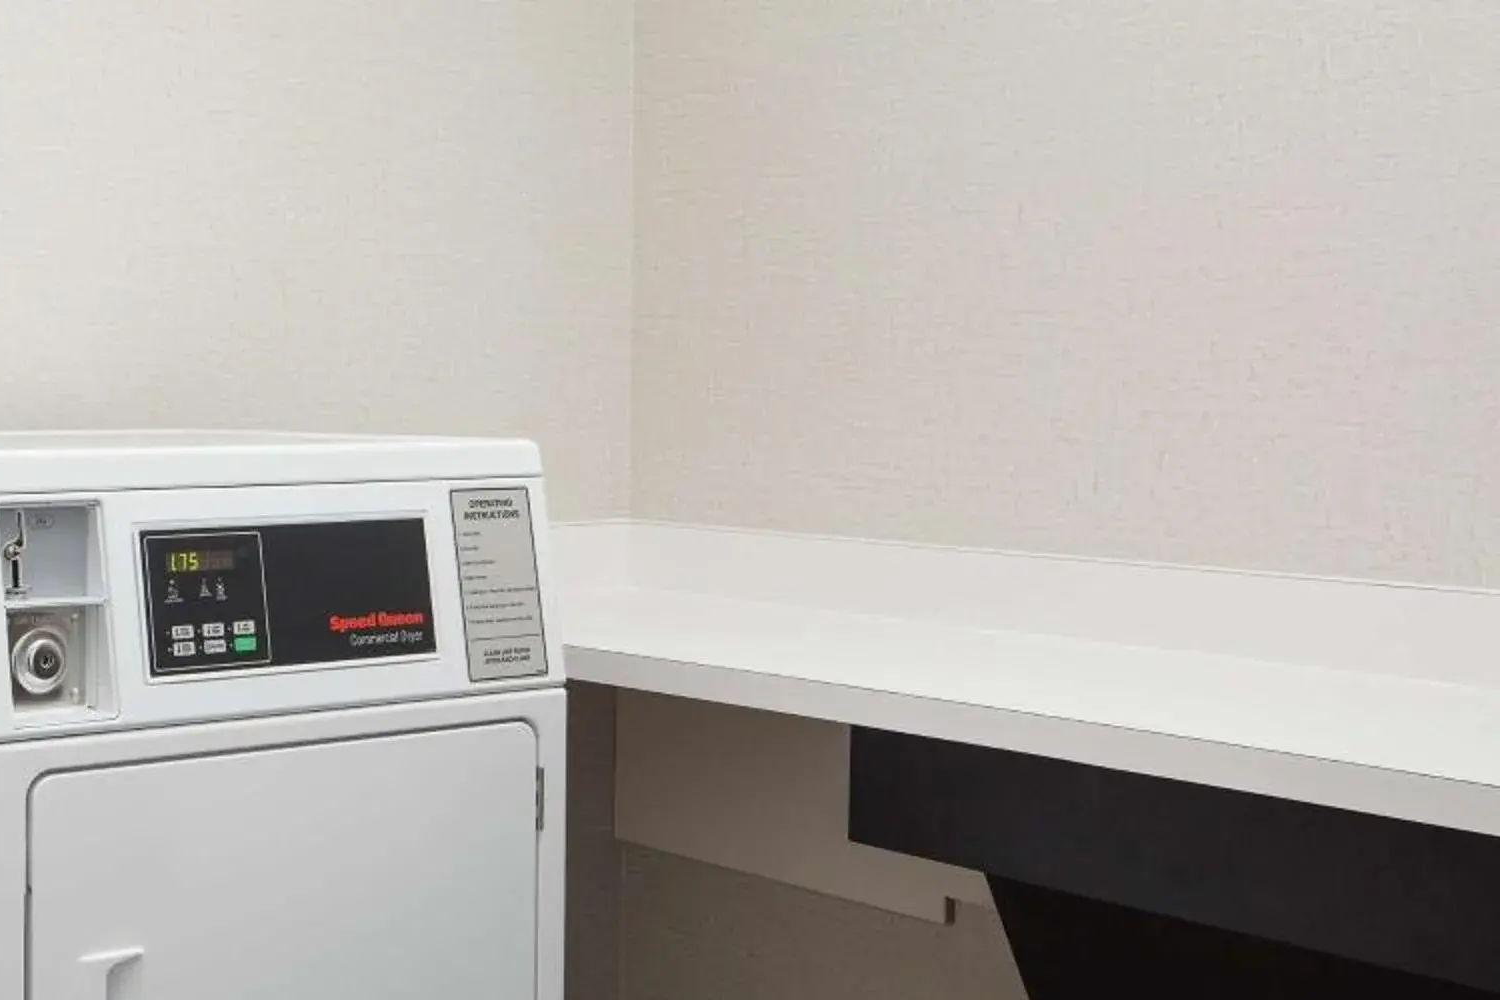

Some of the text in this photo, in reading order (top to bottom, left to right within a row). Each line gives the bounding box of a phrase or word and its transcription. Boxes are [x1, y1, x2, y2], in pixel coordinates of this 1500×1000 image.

[330, 611, 423, 632] Speed Queen
[349, 630, 423, 646] Commercial Dryer
